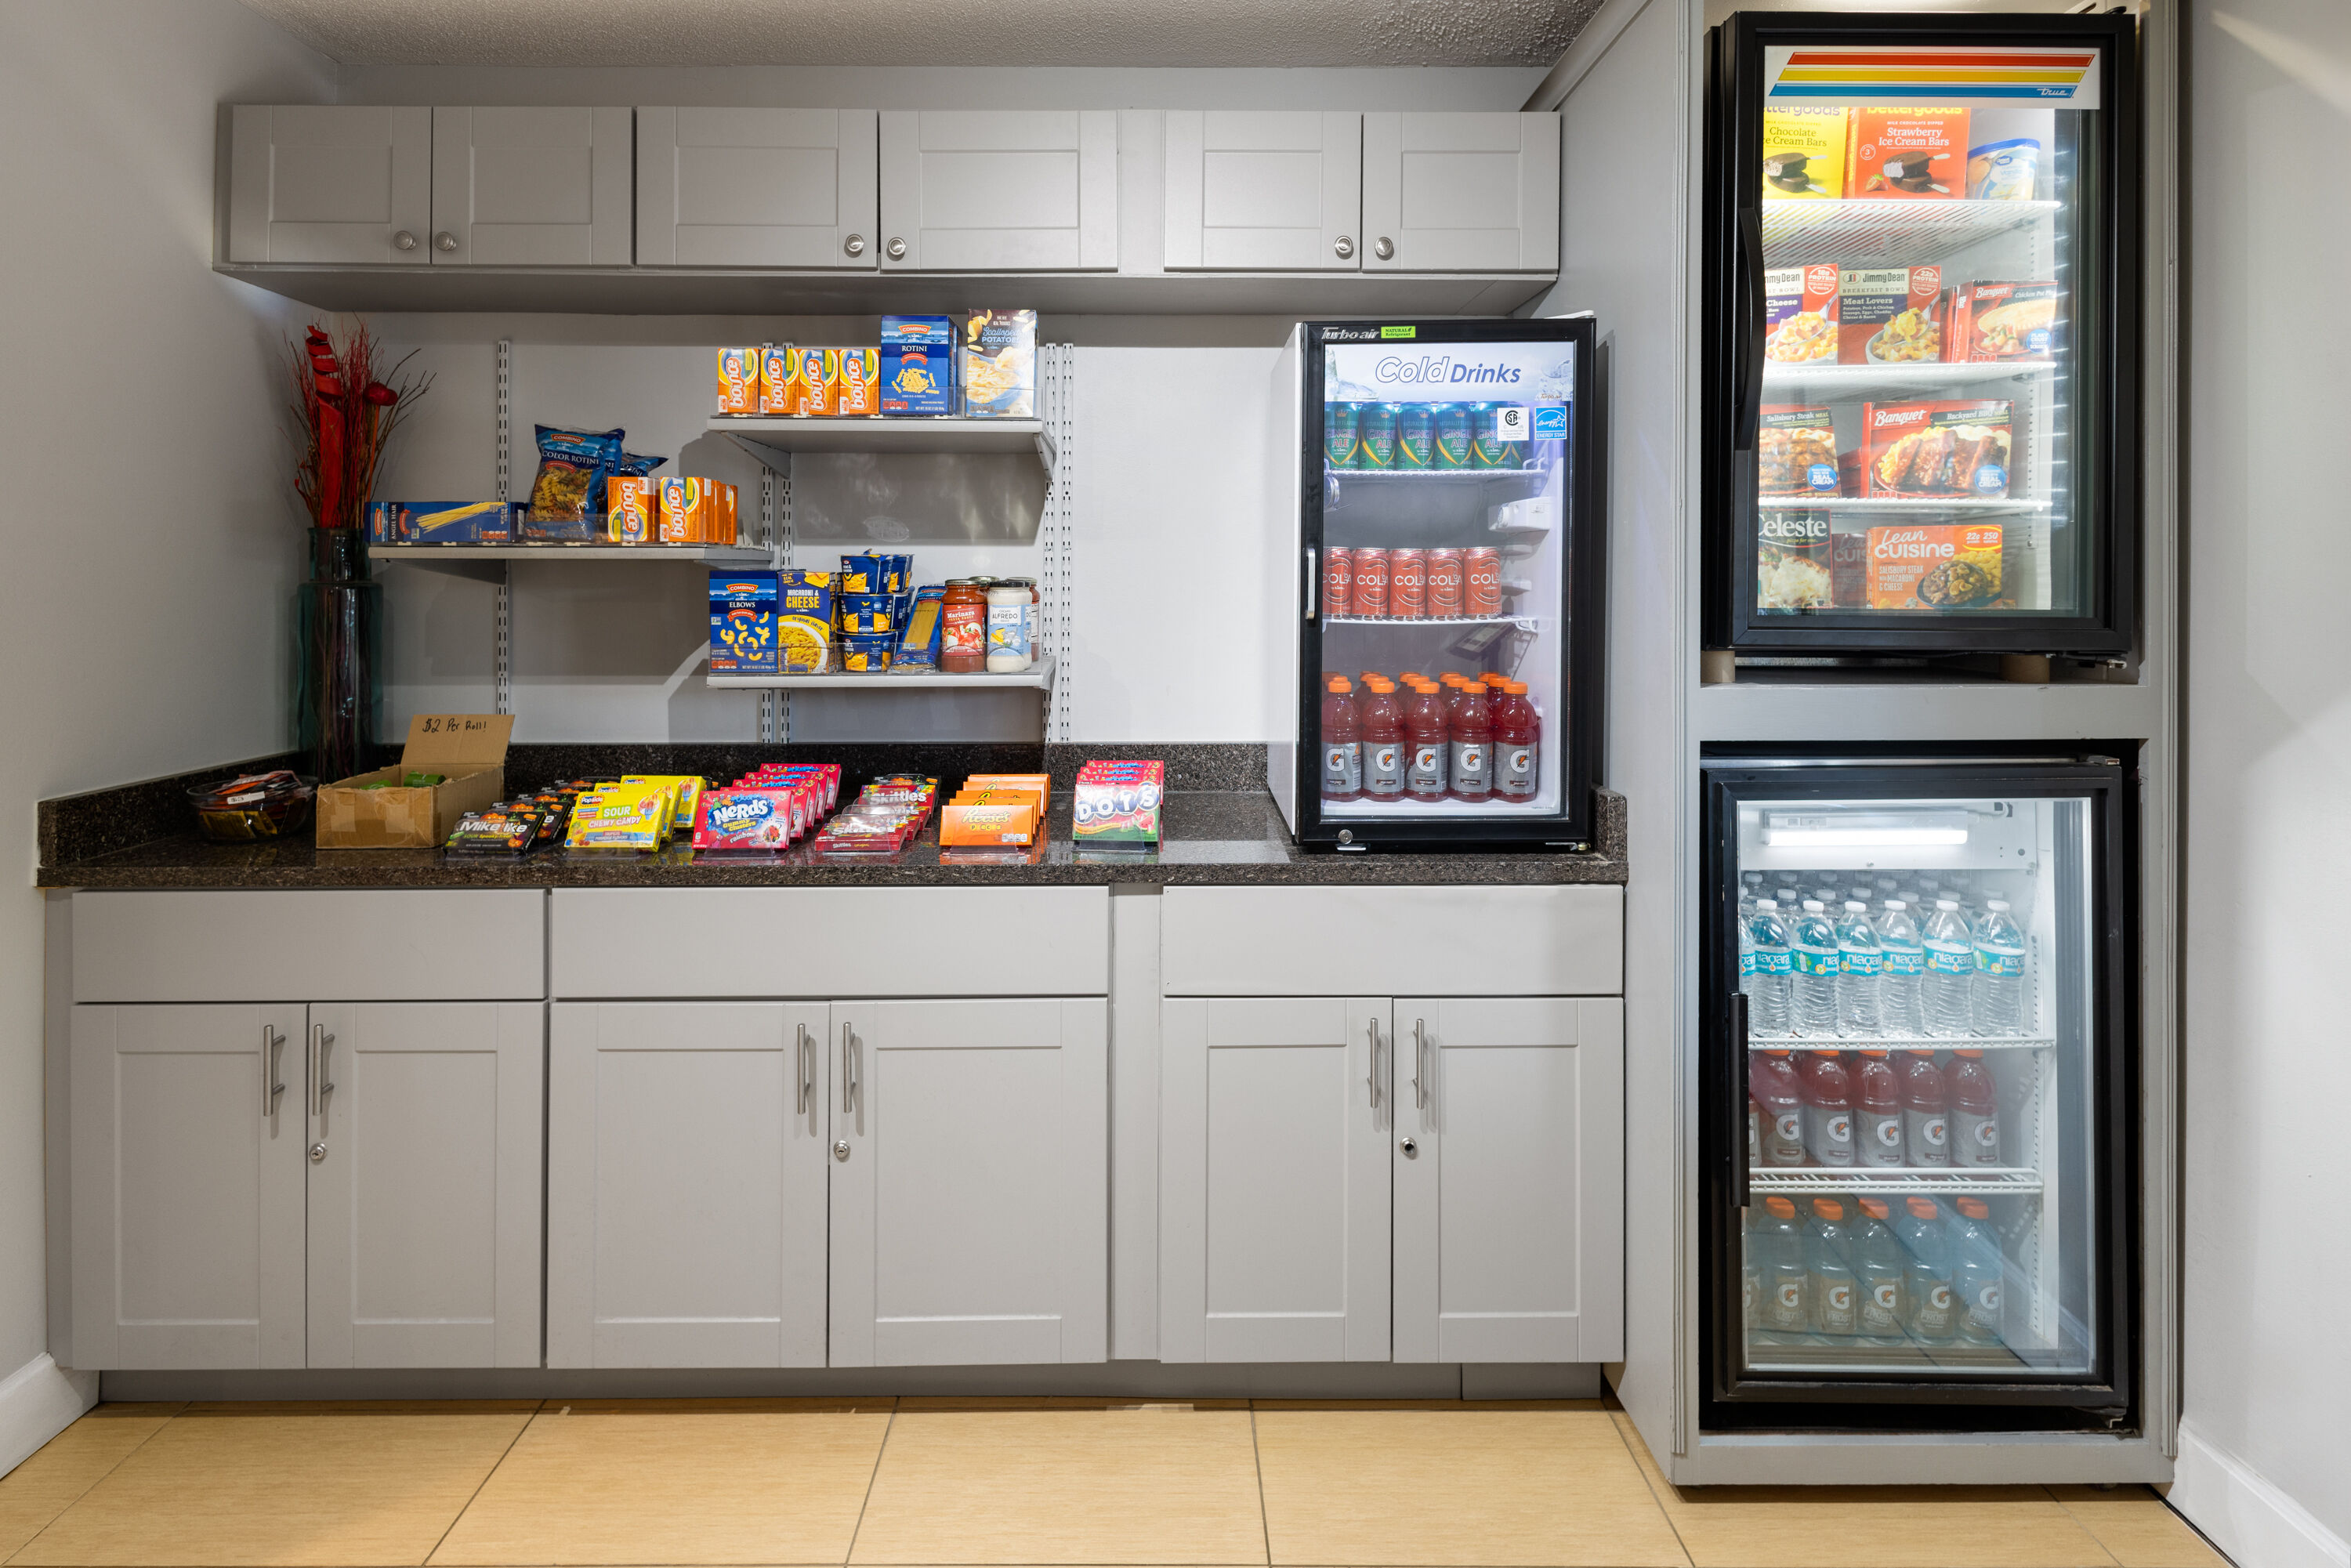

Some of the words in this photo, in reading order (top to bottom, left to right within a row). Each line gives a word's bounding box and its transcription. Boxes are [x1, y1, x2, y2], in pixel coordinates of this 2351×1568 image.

[1770, 126, 1817, 137] Chocolate
[1887, 127, 1943, 138] Strawberry
[1773, 136, 1805, 146] Cream
[1806, 137, 1828, 147] Bars
[1878, 136, 1893, 146] Ice
[1894, 136, 1926, 146] Cream
[1928, 137, 1949, 147] Bars
[1781, 273, 1801, 282] Dean
[1863, 273, 1886, 283] Jimmy
[1886, 273, 1905, 282] Dean
[1975, 287, 2009, 299] Banquet
[1766, 299, 1798, 307] Cheese
[1321, 327, 1359, 339] Turbo
[1360, 329, 1380, 339] air
[1375, 357, 1450, 383] Cold
[1450, 364, 1521, 383] Drinks
[727, 357, 745, 408] bounce
[768, 358, 786, 408] bounce
[807, 360, 826, 411] bounce
[847, 358, 866, 409] bounce
[1766, 413, 1796, 422] Salisbury
[1874, 410, 1926, 427] Banquet
[1947, 411, 1976, 421] Backyard
[553, 435, 582, 444] COMBINO
[1332, 438, 1349, 448] ALE
[1375, 439, 1392, 448] ALE
[1415, 439, 1431, 448] ALE
[1451, 438, 1468, 448] ALE
[542, 450, 570, 461] COLOR
[571, 454, 600, 465] ROTINI
[621, 481, 639, 533] bounce
[669, 487, 686, 538] bounce
[1882, 529, 1929, 545] Lean
[1878, 565, 1907, 574] SALISBURY
[1907, 565, 1924, 574] STEAK
[1884, 583, 1904, 592] CHEESE
[786, 596, 820, 609] CHEESE
[422, 718, 441, 733] $2
[446, 718, 461, 733] Per
[465, 720, 487, 733] Roll!
[1325, 748, 1345, 772] G
[1375, 748, 1396, 773] G
[1415, 748, 1436, 772] G
[1460, 748, 1481, 772] G
[1509, 749, 1530, 773] G
[581, 795, 603, 804] Popsicle
[870, 789, 926, 805] Skittles
[1078, 786, 1156, 820] DOTS
[603, 806, 632, 817] SOUR
[962, 808, 1011, 824] Reese's
[459, 821, 502, 832] Mike
[588, 818, 615, 829] CHEWY
[616, 815, 642, 826] CANDY
[723, 818, 751, 829] Gummy
[728, 820, 756, 832] Clusters
[730, 831, 756, 844] rainbow
[1846, 953, 1882, 966] niagara
[1934, 951, 1973, 965] niagara
[1776, 1114, 1799, 1141] G
[1827, 1116, 1850, 1143] G
[1876, 1120, 1900, 1147] G
[1922, 1119, 1946, 1146] G
[1973, 1120, 1997, 1147] G
[1777, 1284, 1799, 1308] G
[1828, 1285, 1849, 1310] G
[1874, 1284, 1896, 1309] G
[1930, 1284, 1951, 1310] G
[1979, 1284, 1999, 1310] G
